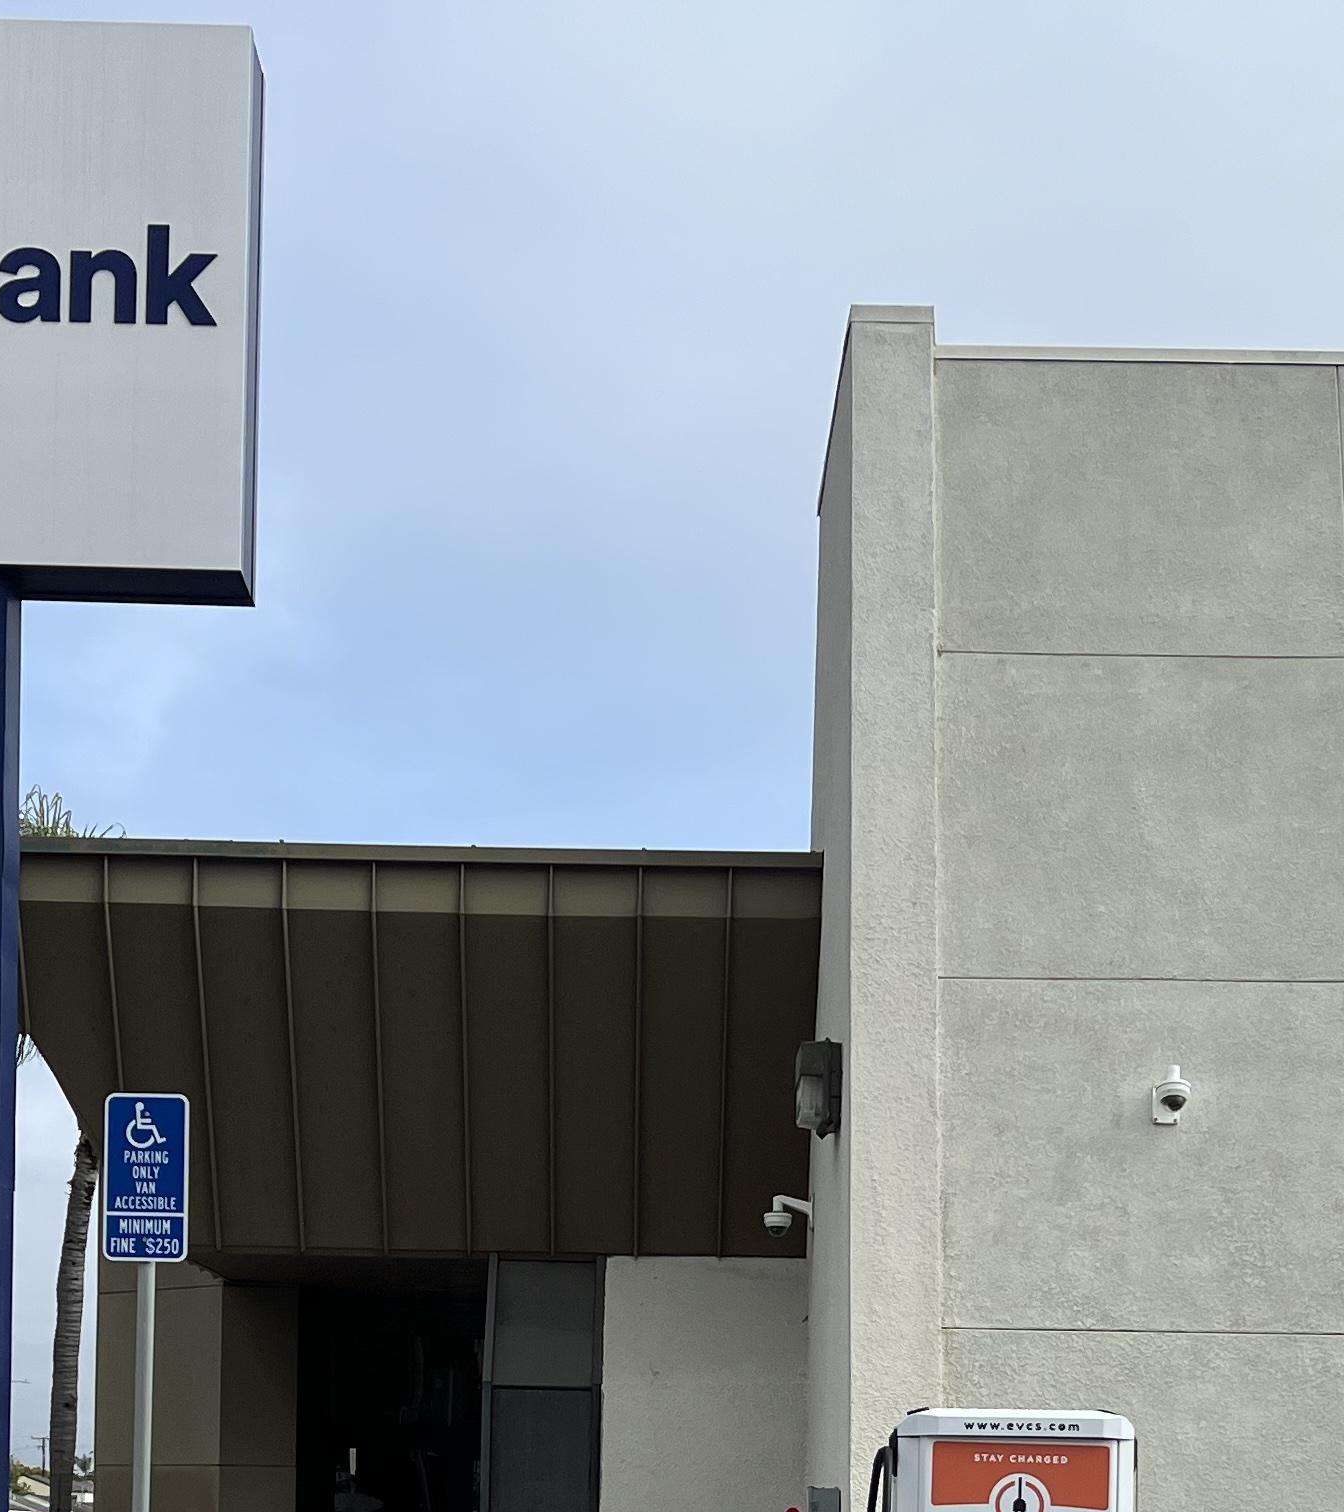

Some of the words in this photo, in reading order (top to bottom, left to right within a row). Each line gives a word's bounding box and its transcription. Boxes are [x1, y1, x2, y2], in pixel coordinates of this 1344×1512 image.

[124, 1150, 169, 1164] PARKING
[132, 1165, 160, 1179] ONLY
[135, 1181, 156, 1194] VAN
[114, 1196, 177, 1210] ACCESSIBLE
[119, 1218, 171, 1235] MINIMUM
[110, 1237, 136, 1253] FINE
[145, 1237, 180, 1254] $250
[964, 1421, 1080, 1432] www.evcs.com
[974, 1453, 1004, 1463] STAY
[1009, 1454, 1068, 1464] CHARGED
